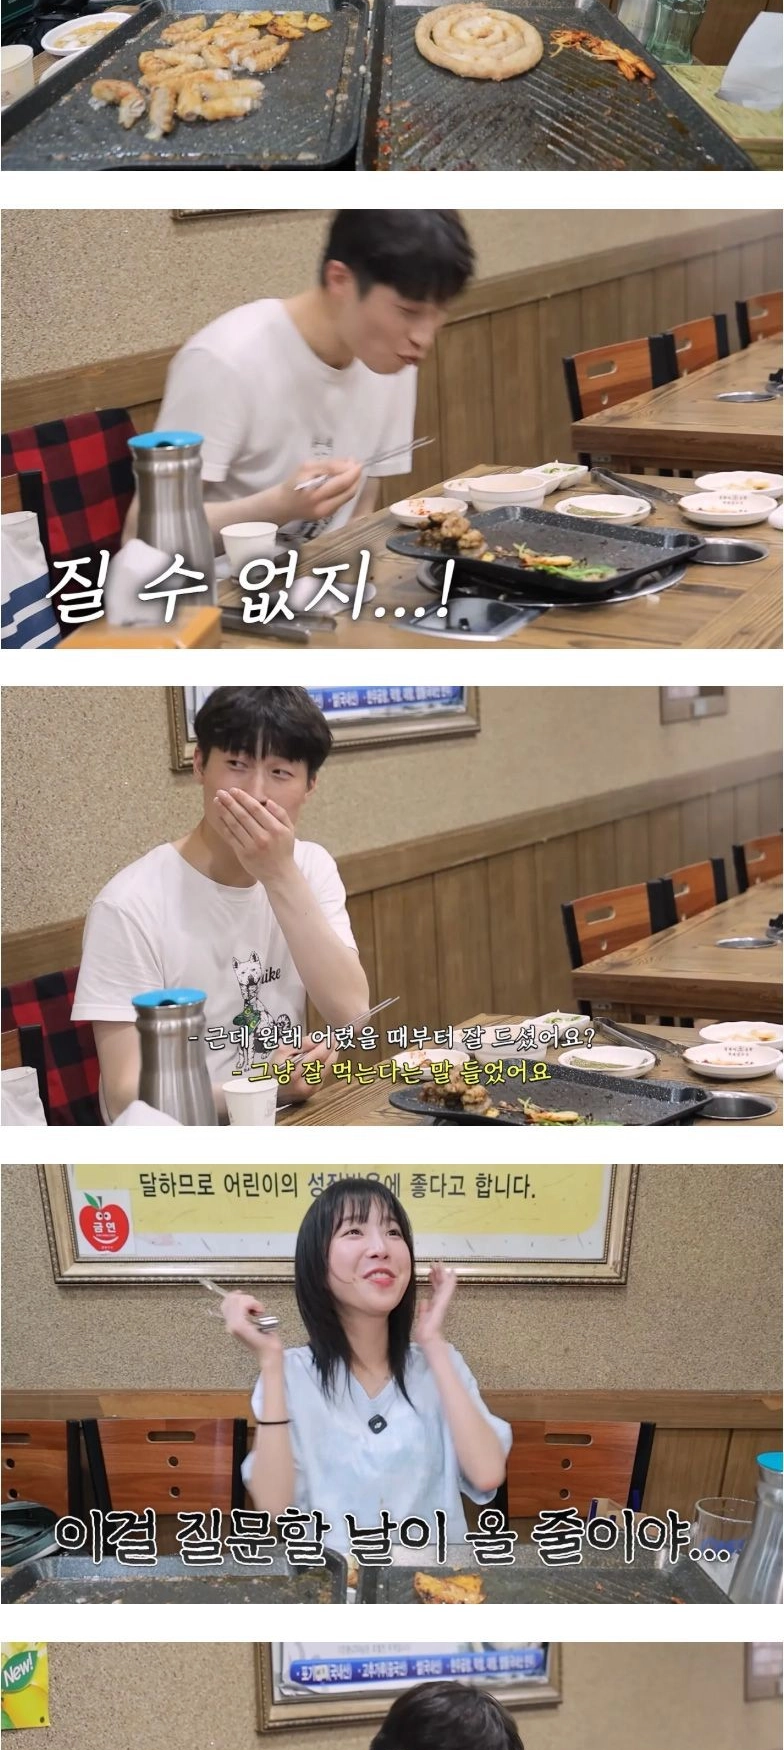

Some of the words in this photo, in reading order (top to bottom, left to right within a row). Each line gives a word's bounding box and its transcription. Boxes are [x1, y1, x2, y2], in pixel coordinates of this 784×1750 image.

[139, 1172, 215, 1198] 달하므로
[223, 1172, 298, 1198] 어린이의
[409, 1172, 466, 1198] 좋다고
[475, 1173, 536, 1199] 합니다.
[93, 1220, 117, 1235] 금연
[3, 1651, 34, 1688] New!
